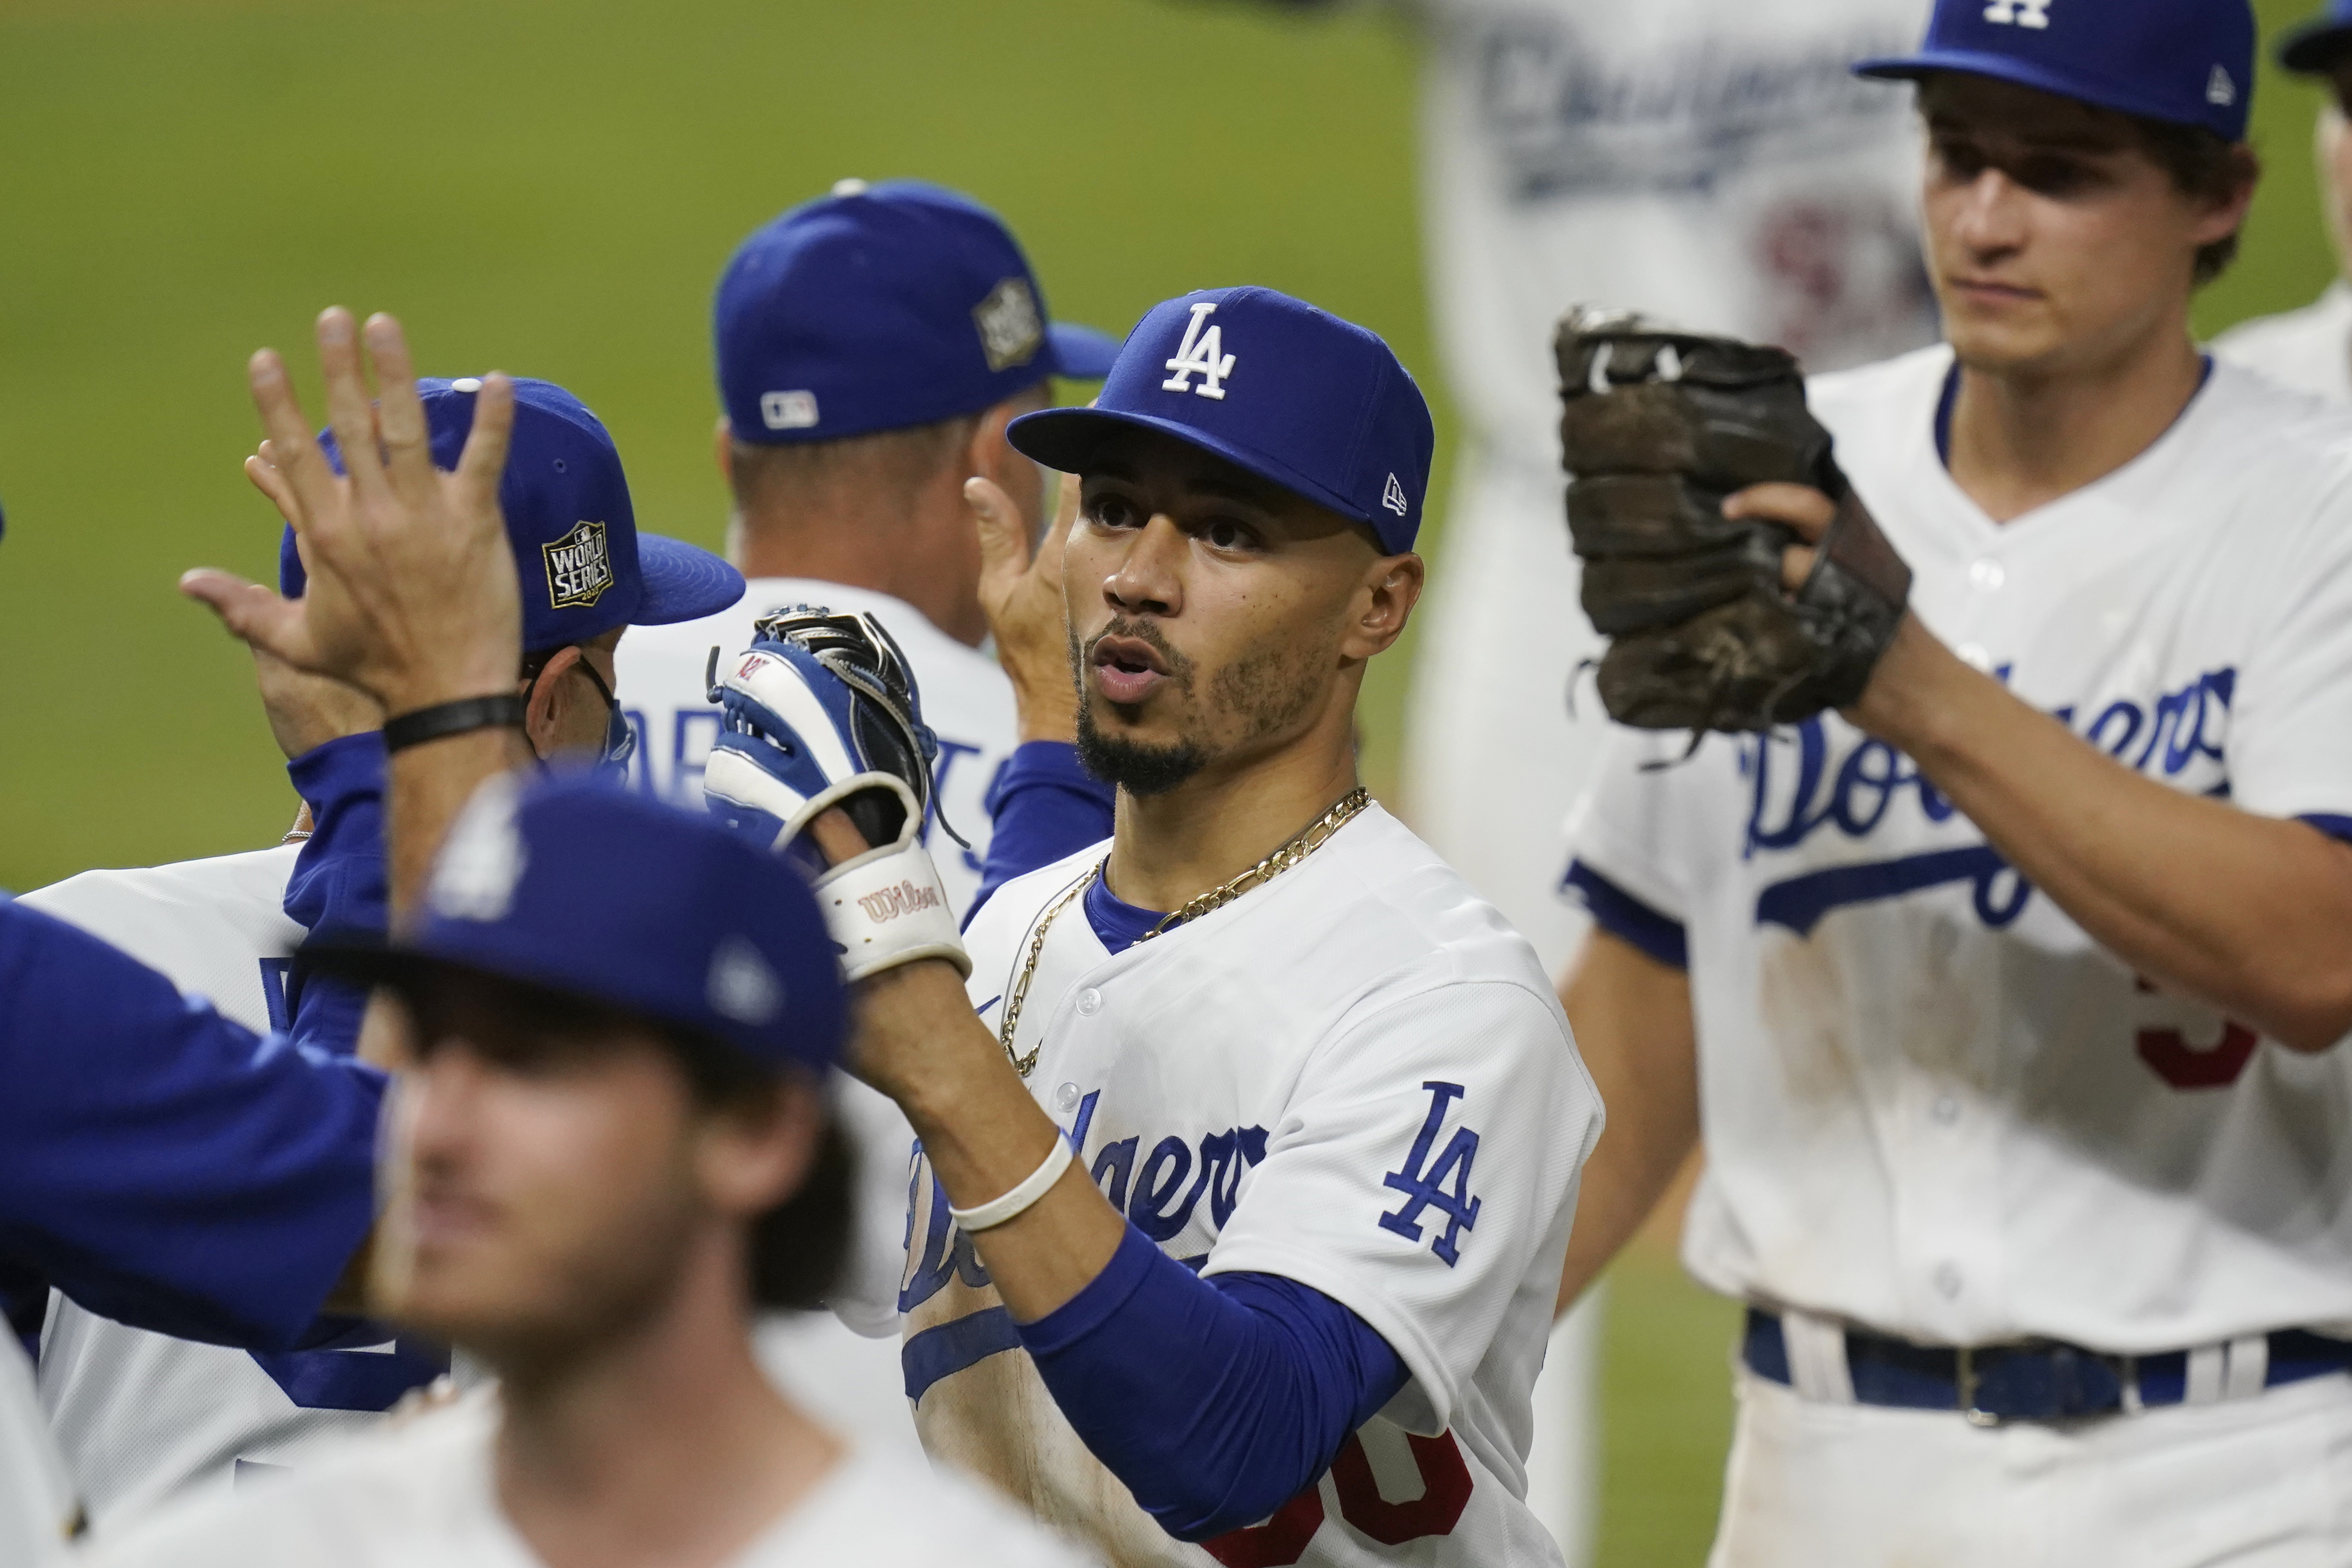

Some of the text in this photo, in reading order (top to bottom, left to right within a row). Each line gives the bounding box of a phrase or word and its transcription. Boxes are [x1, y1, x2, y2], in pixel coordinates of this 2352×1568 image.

[1162, 303, 1236, 401] LA
[551, 533, 604, 574] WORLD
[555, 555, 608, 598] SERIES
[857, 879, 939, 924] Wilson
[1377, 1080, 1482, 1269] LA
